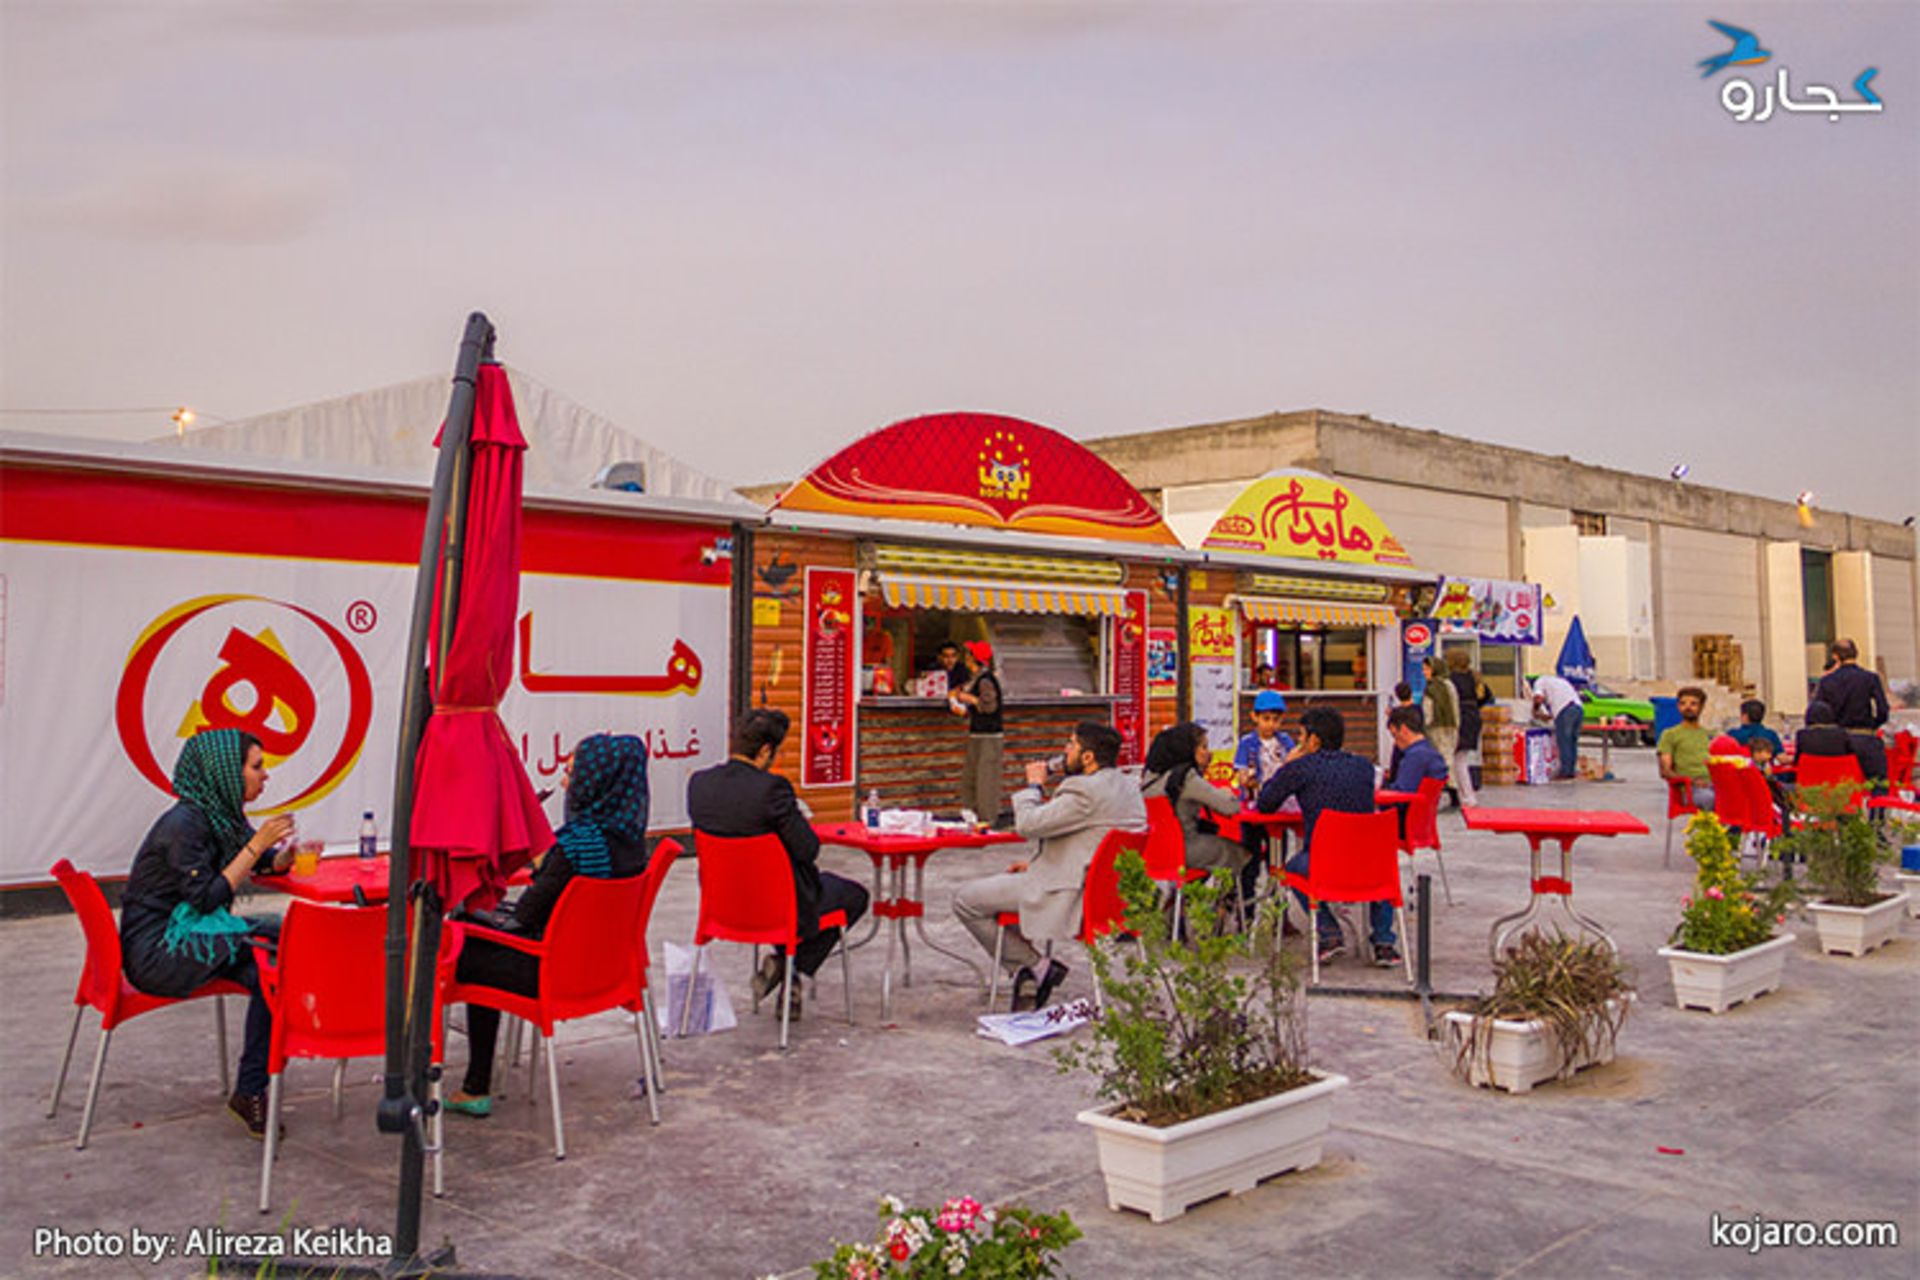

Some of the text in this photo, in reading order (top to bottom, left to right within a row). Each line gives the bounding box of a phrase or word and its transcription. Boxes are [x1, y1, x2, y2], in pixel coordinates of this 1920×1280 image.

[1261, 478, 1373, 560] هایدا
[519, 611, 702, 697] ها
[645, 728, 700, 760] غذا
